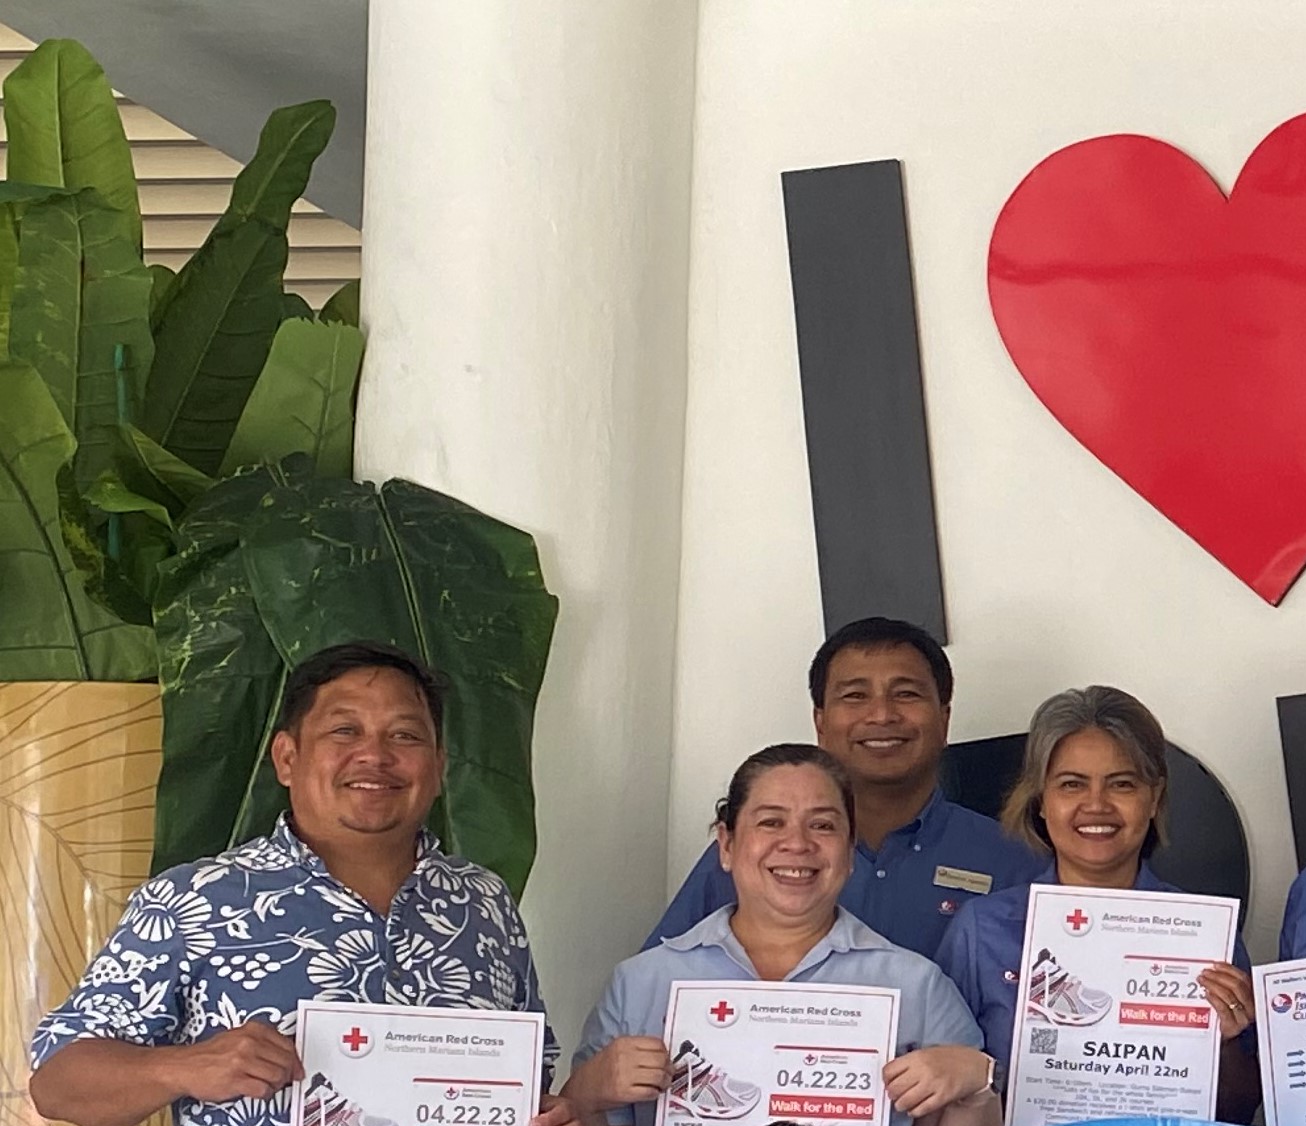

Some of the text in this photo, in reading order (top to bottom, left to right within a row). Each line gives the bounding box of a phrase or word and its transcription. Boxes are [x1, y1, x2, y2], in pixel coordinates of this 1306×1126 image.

[1102, 912, 1202, 927] American Red Cross
[749, 1004, 861, 1017] American Red Cross
[1120, 1008, 1208, 1023] Walk for the Red
[385, 1031, 504, 1046] American Red Cross
[1082, 1040, 1166, 1061] SAIPAN
[1044, 1057, 1188, 1078] Saturday April 22nd
[776, 1069, 871, 1090] 04.22.23
[416, 1103, 516, 1126] 04.22.23
[769, 1100, 872, 1114] Walk for the Red
